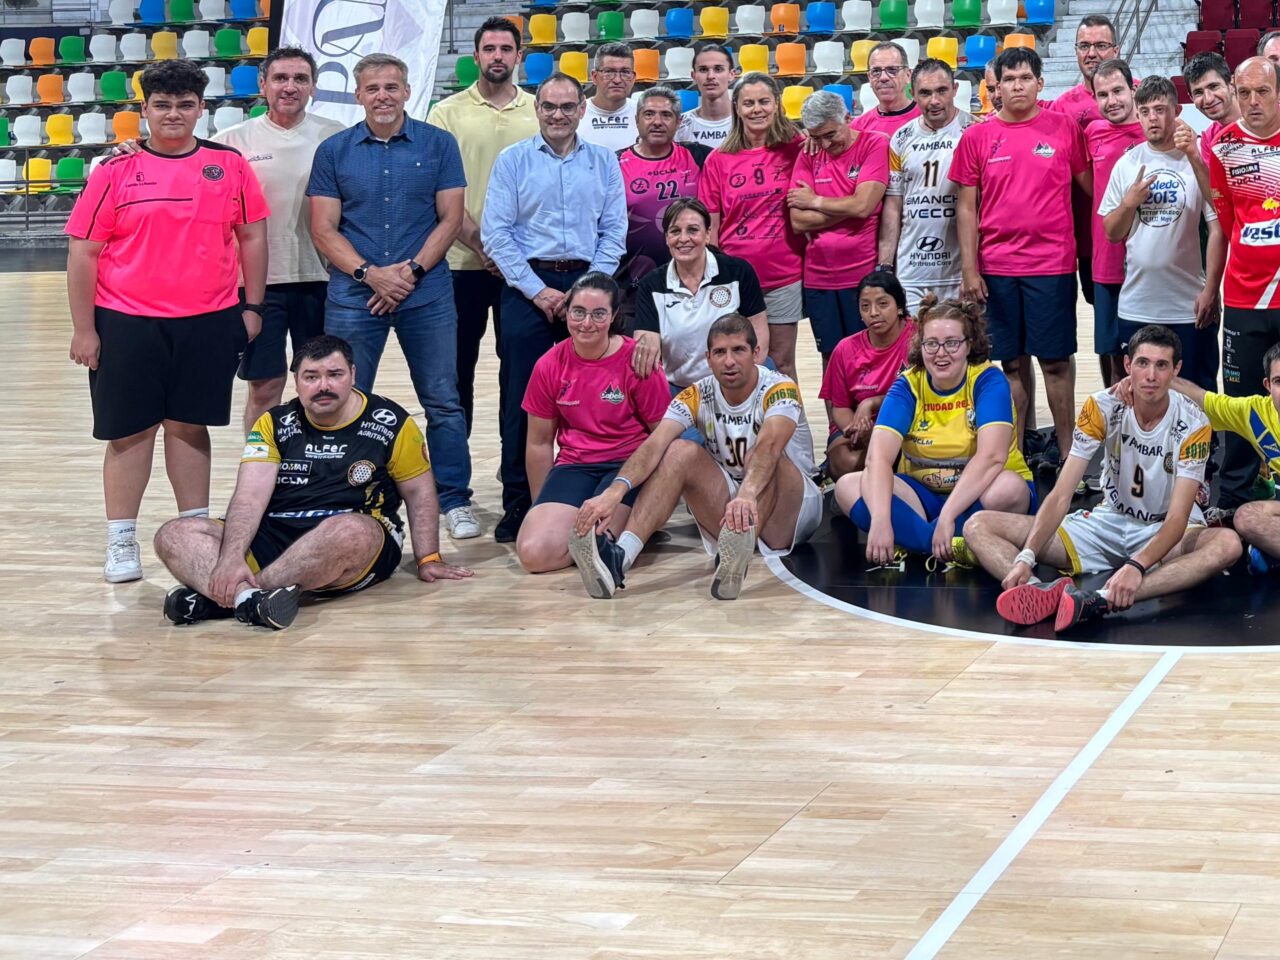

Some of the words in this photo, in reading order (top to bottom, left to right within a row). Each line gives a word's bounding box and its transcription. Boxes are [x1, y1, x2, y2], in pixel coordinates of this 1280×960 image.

[700, 130, 727, 139] AMBA
[919, 141, 953, 152] AMBAR
[653, 168, 678, 177] UCLM
[754, 167, 764, 185] 9
[923, 159, 940, 187] 11
[656, 180, 680, 201] 22
[1149, 179, 1180, 191] oledo
[1143, 190, 1178, 205] 2013
[910, 252, 951, 261] HYUNDAI
[924, 401, 954, 412] CIUDAD
[361, 421, 395, 441] HYUNDAI
[726, 437, 747, 468] 30
[1129, 436, 1164, 457] AMBAR
[1131, 464, 1144, 498] 9
